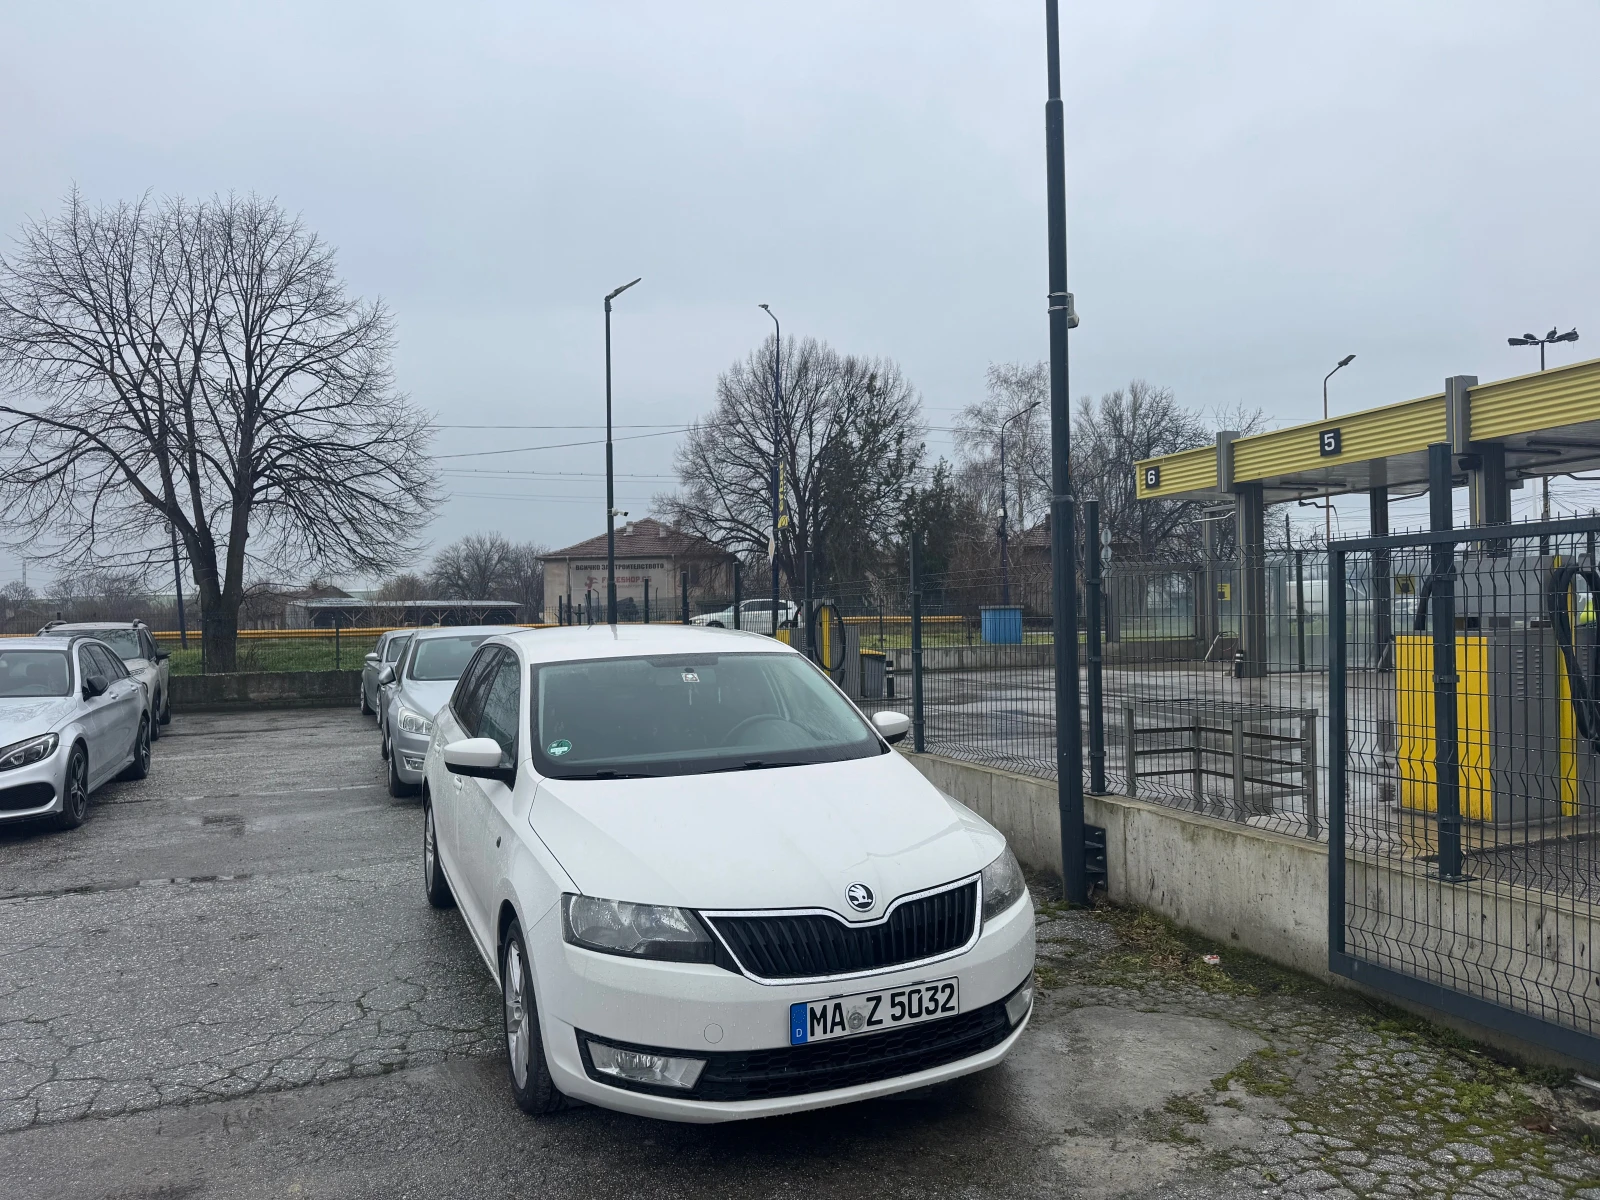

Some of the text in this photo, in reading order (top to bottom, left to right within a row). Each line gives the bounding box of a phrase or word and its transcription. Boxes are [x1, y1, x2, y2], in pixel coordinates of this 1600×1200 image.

[1324, 433, 1335, 451] 5
[1147, 470, 1156, 485] 6
[809, 983, 955, 1037] MA Z 5032
[796, 1029, 803, 1038] D
